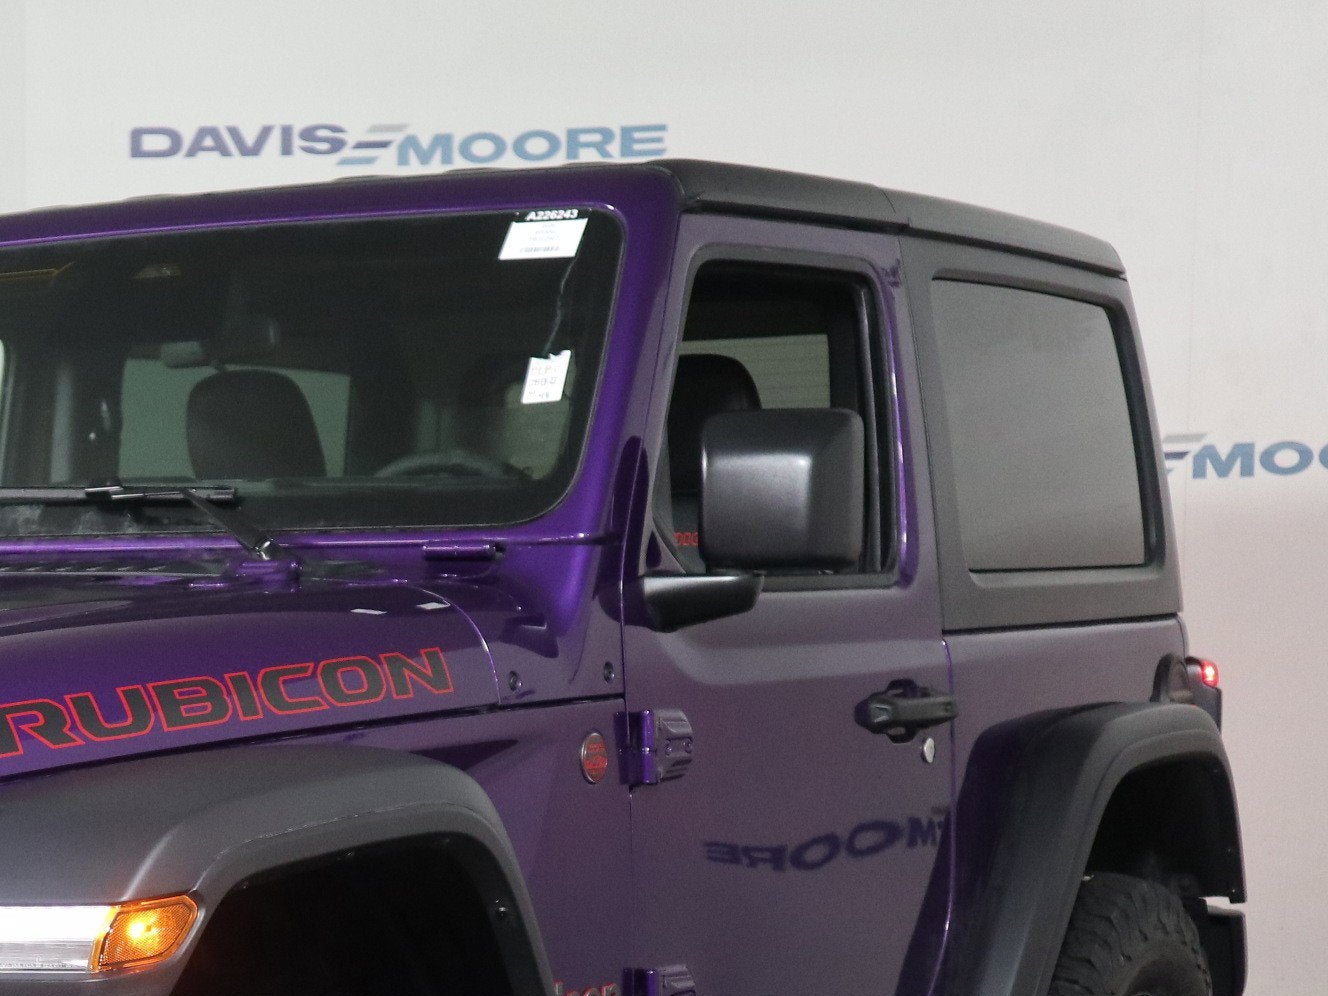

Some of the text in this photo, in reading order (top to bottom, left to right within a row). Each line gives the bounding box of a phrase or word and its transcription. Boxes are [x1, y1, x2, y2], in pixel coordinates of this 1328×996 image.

[128, 123, 669, 167] DAVIS MOORE
[1191, 440, 1328, 480] MO
